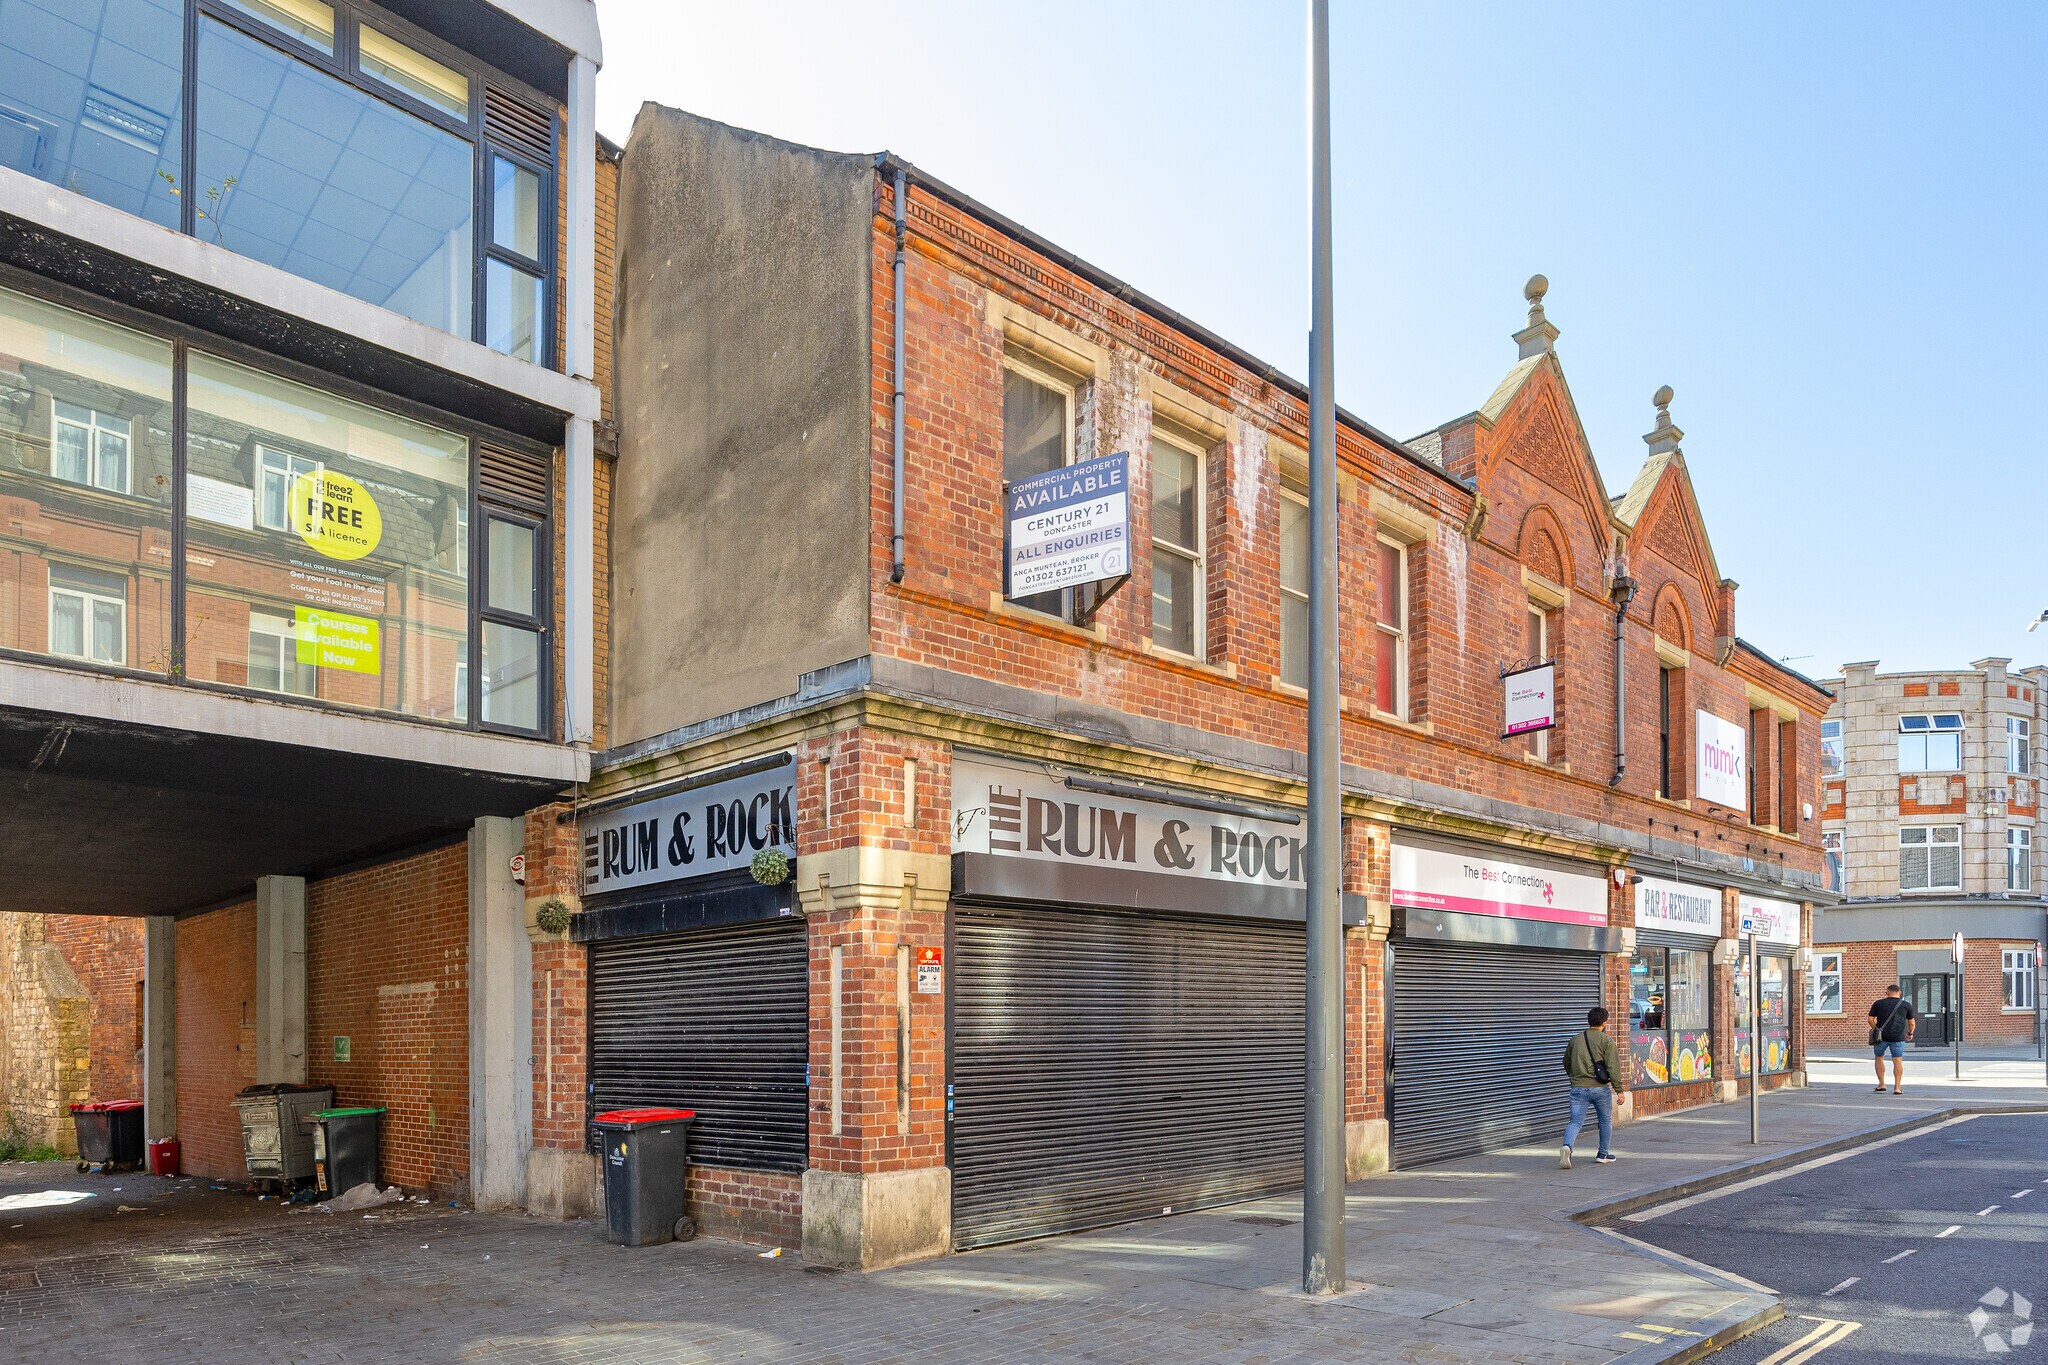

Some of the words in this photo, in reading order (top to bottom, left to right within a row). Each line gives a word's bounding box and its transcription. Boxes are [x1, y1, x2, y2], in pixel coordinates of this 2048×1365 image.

[1012, 473, 1071, 494] COMMERCIAL
[1073, 457, 1123, 477] PROPERTY
[326, 481, 353, 496] free2
[326, 489, 353, 503] learn
[1014, 469, 1121, 511] AVAILABLE
[308, 498, 362, 529] FREE
[1028, 507, 1091, 531] CENTURY
[1096, 502, 1109, 515] 21
[329, 529, 368, 546] licence
[1044, 520, 1092, 537] DONCASTER
[1016, 547, 1041, 561] ALL
[1045, 527, 1122, 554] ENQUIRIES
[326, 566, 337, 574] FREE
[338, 569, 361, 578] SECURITY
[1014, 568, 1032, 577] ANCA
[1034, 560, 1069, 574] MUNTEAN,
[1071, 553, 1099, 564] BROKER
[1025, 572, 1053, 584] 01302
[1056, 564, 1087, 577] 637121
[290, 570, 305, 579] Get
[306, 574, 324, 583] your
[344, 581, 352, 589] in
[353, 583, 365, 591] the
[367, 586, 385, 595] door
[290, 583, 321, 594] CONTACT
[316, 595, 331, 604] CALL
[352, 602, 372, 611] TODAY
[308, 614, 368, 635] Courses
[304, 630, 373, 652] Available
[323, 651, 356, 666] Now
[585, 828, 599, 892] THE
[603, 818, 659, 879] RUM
[667, 811, 695, 867] &
[706, 785, 794, 859] ROCK
[989, 785, 1021, 854] THE
[1026, 796, 1137, 864] RUM
[1154, 819, 1196, 871] &
[1463, 864, 1479, 880] The
[1501, 871, 1545, 888] Connection
[1645, 888, 1660, 918] BAR
[1661, 891, 1668, 920] &
[1669, 892, 1711, 926] RESTAURANT
